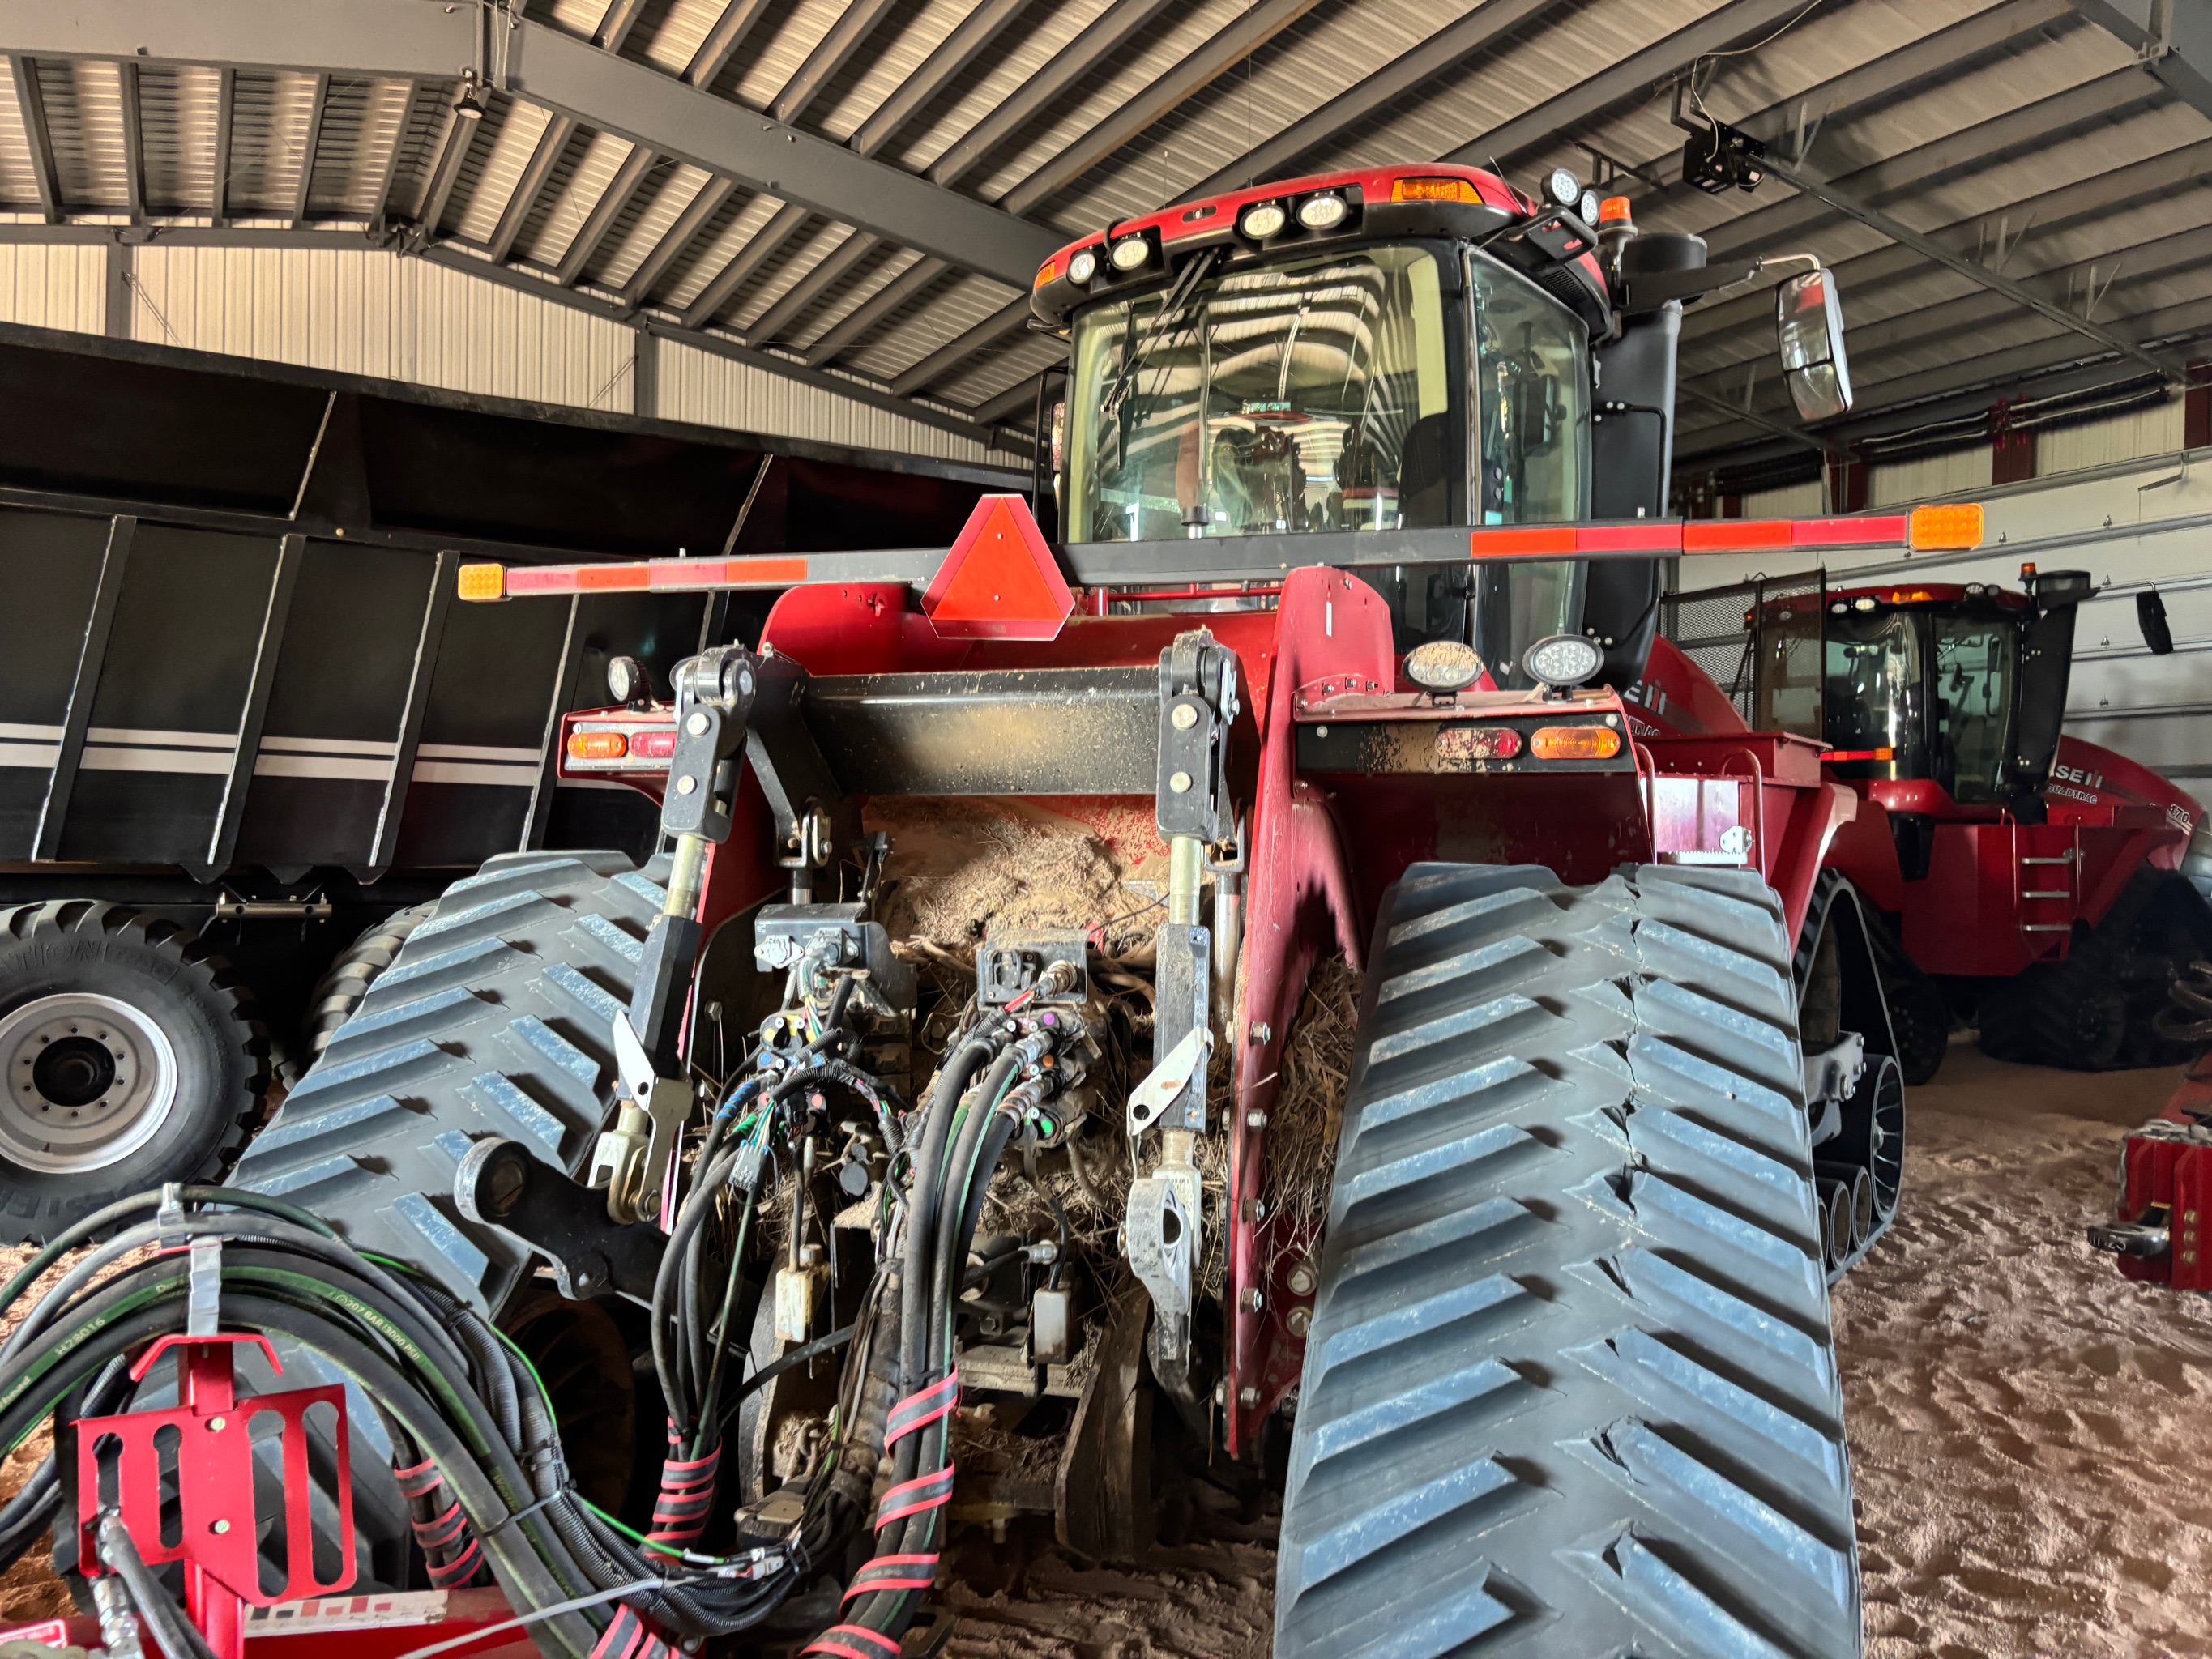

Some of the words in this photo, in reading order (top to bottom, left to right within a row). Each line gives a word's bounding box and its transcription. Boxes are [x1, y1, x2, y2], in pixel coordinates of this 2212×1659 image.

[2169, 804, 2190, 824] 470
[346, 1299, 365, 1313] 207
[363, 1310, 384, 1327] BAR
[54, 1316, 105, 1355] H28016
